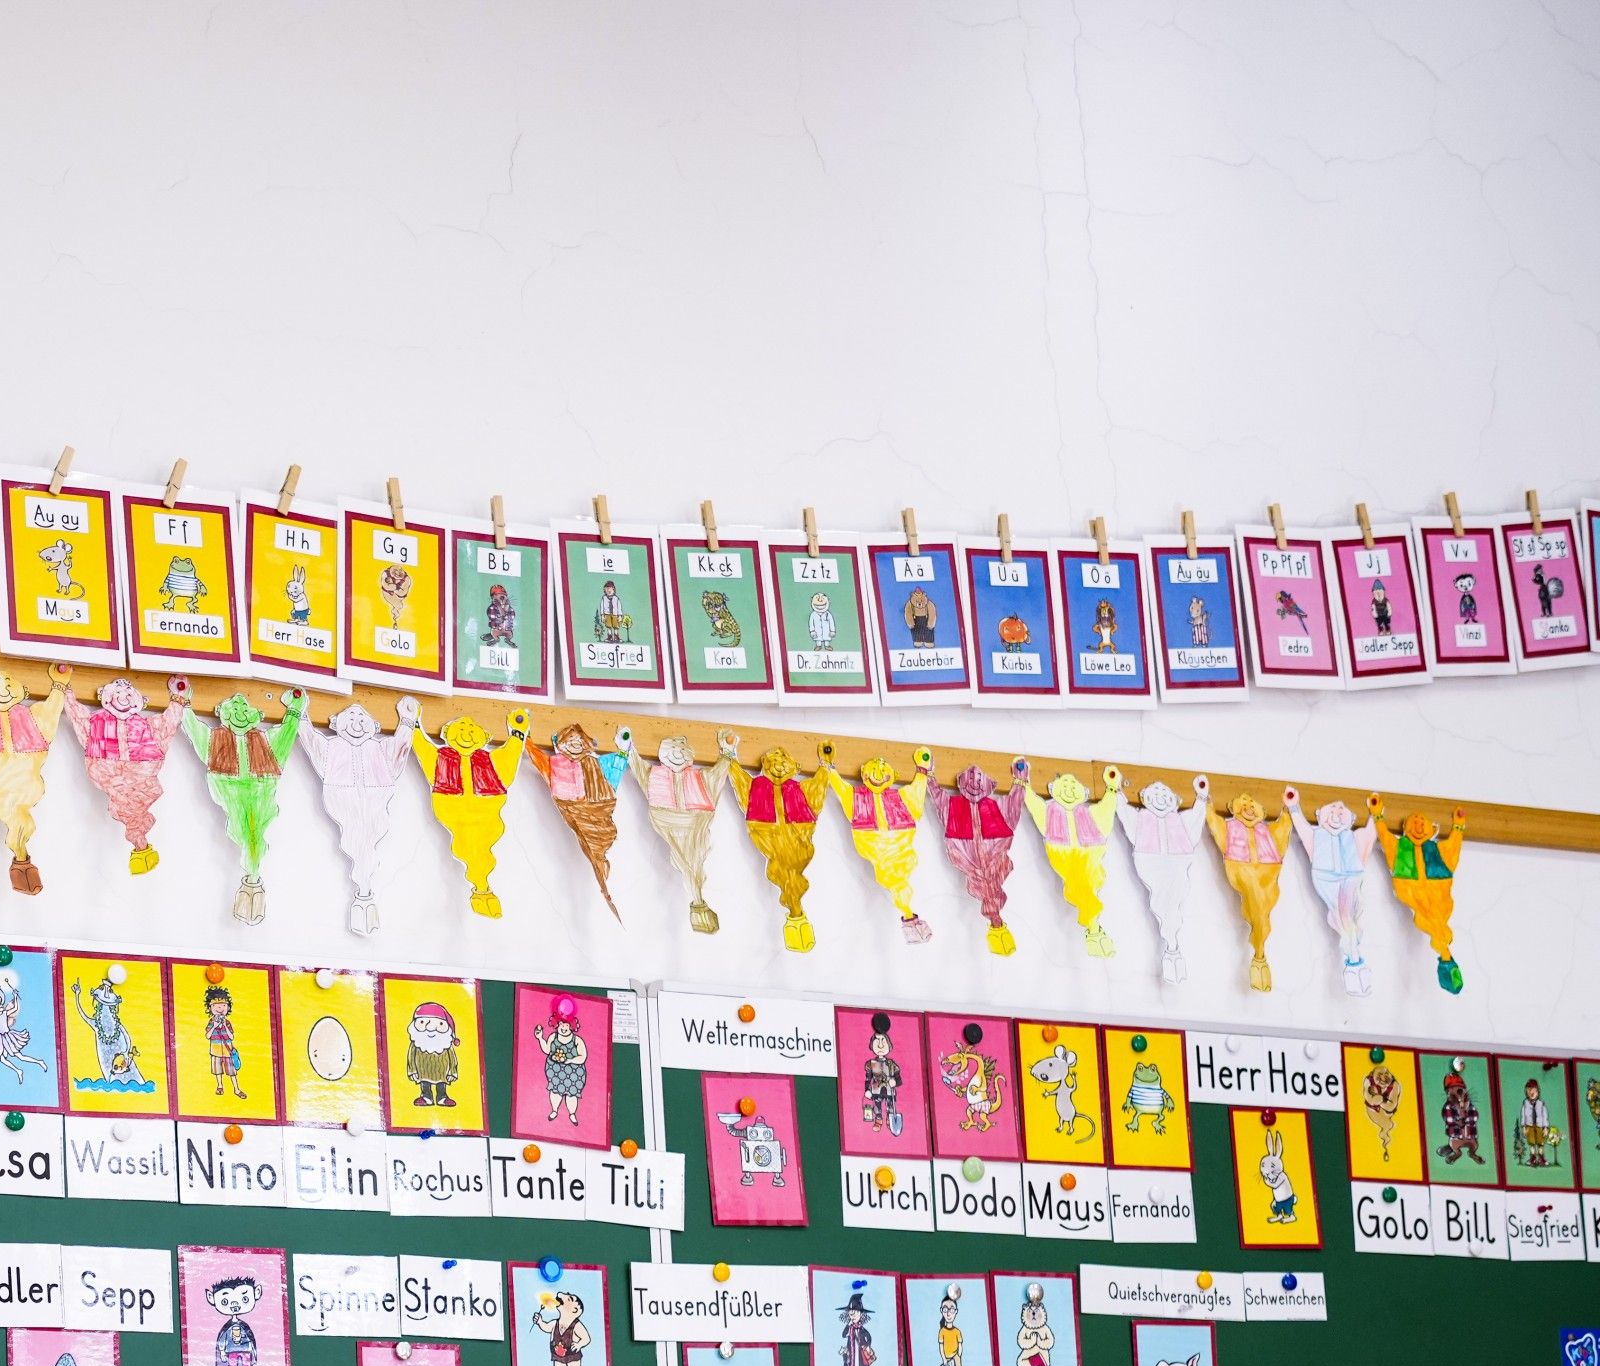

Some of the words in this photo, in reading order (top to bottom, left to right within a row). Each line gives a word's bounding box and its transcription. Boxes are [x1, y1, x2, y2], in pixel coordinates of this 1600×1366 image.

[34, 505, 55, 524] Au
[61, 513, 80, 527] au
[168, 519, 176, 535] F
[181, 520, 191, 544] f
[286, 532, 296, 547] H
[300, 534, 310, 550] h
[383, 538, 394, 554] G
[399, 544, 409, 563] g
[603, 554, 614, 568] ie
[1451, 544, 1459, 558] V
[1463, 549, 1469, 557] v
[488, 555, 497, 569] B
[501, 557, 510, 571] b
[697, 555, 706, 571] K
[708, 557, 715, 572] k
[719, 557, 733, 573] ck
[801, 562, 809, 578] Z
[811, 570, 817, 579] z
[820, 564, 831, 580] tz
[904, 559, 914, 577] Ä
[917, 563, 924, 578] ä
[998, 563, 1006, 581] Ü
[1011, 568, 1019, 583] ü
[1177, 562, 1192, 579] Äu
[1196, 564, 1209, 581] äu
[1263, 553, 1269, 568] P
[1272, 560, 1278, 574] p
[1281, 555, 1292, 575] Pf
[1367, 554, 1373, 568] J
[1376, 557, 1381, 574] j
[1091, 565, 1101, 584] Ö
[1104, 569, 1111, 584] ö
[45, 601, 82, 619] Maus
[150, 613, 219, 636] Fernando
[266, 625, 292, 642] Herr
[296, 630, 325, 648] Hase
[381, 630, 410, 651] Golo
[1391, 637, 1414, 655] Sepp
[489, 651, 510, 667] Bill
[588, 644, 644, 668] Siegfried
[714, 651, 739, 666] Krok
[797, 655, 812, 669] Dr.
[814, 654, 856, 670] Zahnritz
[898, 653, 954, 668] Zauberbär
[1001, 655, 1033, 672] Kürbis
[1084, 657, 1110, 671] Löwe
[1113, 658, 1131, 673] Leo
[1178, 651, 1228, 665] Kläuschen
[681, 1018, 832, 1053] Wettermaschine
[1195, 1045, 1261, 1091] Herr
[1268, 1051, 1339, 1098] Hase
[71, 1140, 169, 1176] Wassil
[187, 1138, 278, 1192] Nino
[295, 1144, 379, 1197] Eilin
[393, 1160, 484, 1194] Rochus
[492, 1156, 585, 1201] Tante
[601, 1163, 666, 1211] Tilli
[845, 1171, 928, 1212] Ulrich
[941, 1174, 1018, 1218] Dodo
[1028, 1180, 1105, 1224] Maus
[1112, 1193, 1191, 1219] Fernando
[1357, 1196, 1429, 1241] Golo
[1446, 1200, 1496, 1244] Bill
[1508, 1214, 1579, 1248] Siegfried
[81, 1271, 155, 1324] Sepp
[298, 1275, 396, 1328] Spinne
[404, 1278, 498, 1318] Stanko
[634, 1288, 783, 1328] Tausendfüßler
[1245, 1289, 1325, 1308] Schweinchen
